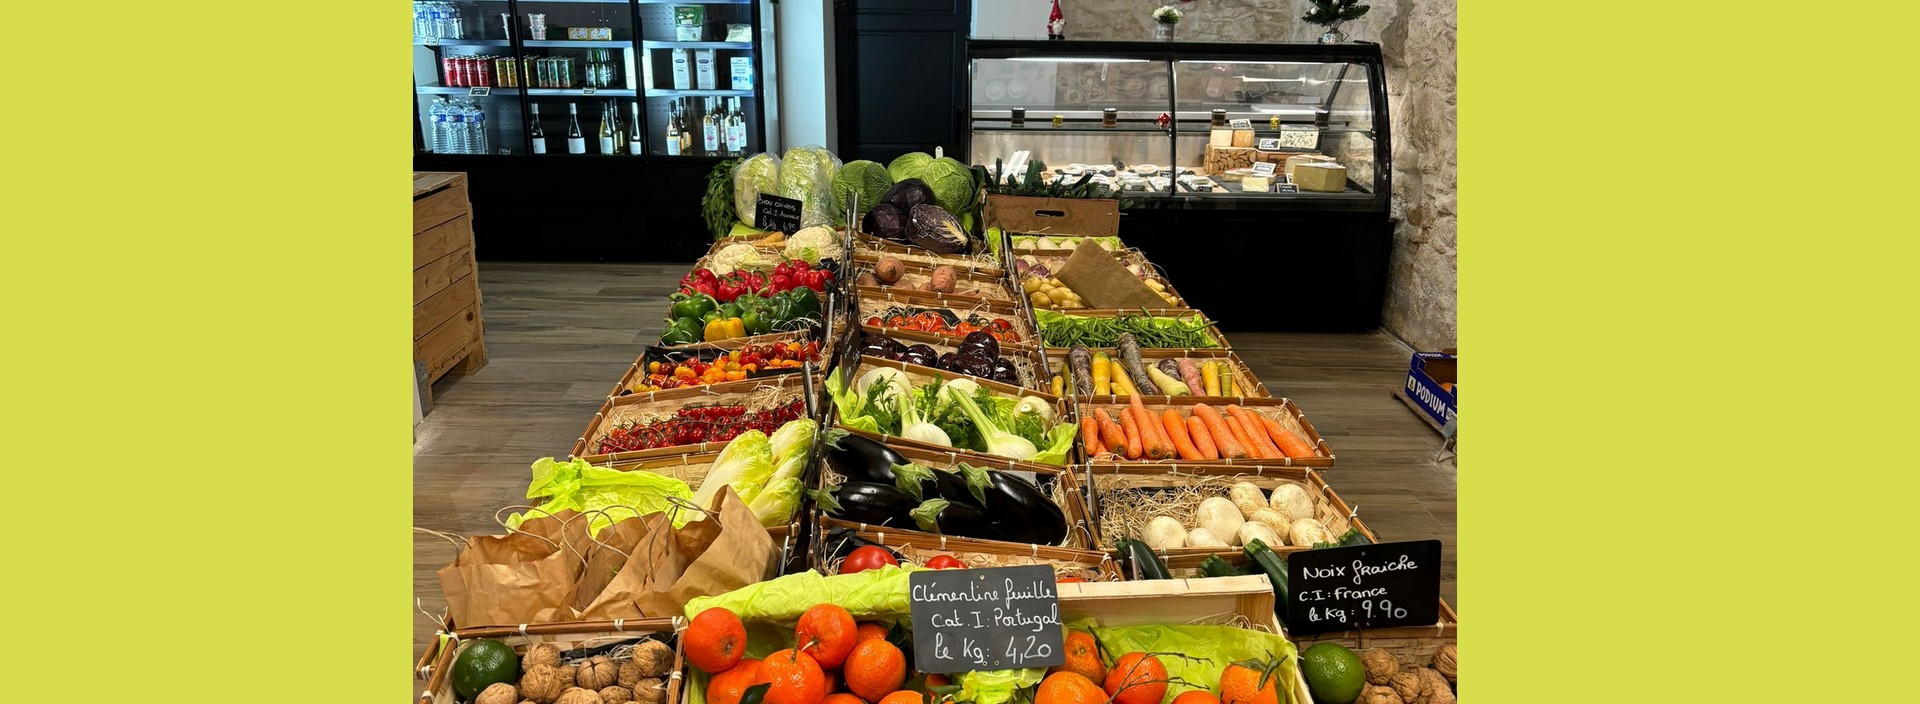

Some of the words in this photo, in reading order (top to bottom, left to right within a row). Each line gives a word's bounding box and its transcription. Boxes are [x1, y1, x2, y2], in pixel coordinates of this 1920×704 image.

[1415, 381, 1446, 417] PODIUM
[912, 580, 1000, 602] Clémentine
[1004, 577, 1056, 610] feuille
[993, 602, 1062, 632] Portugal
[1308, 606, 1323, 622] le
[1361, 599, 1408, 619] 9.90
[934, 632, 954, 660] le
[1005, 635, 1052, 664] 4,20
